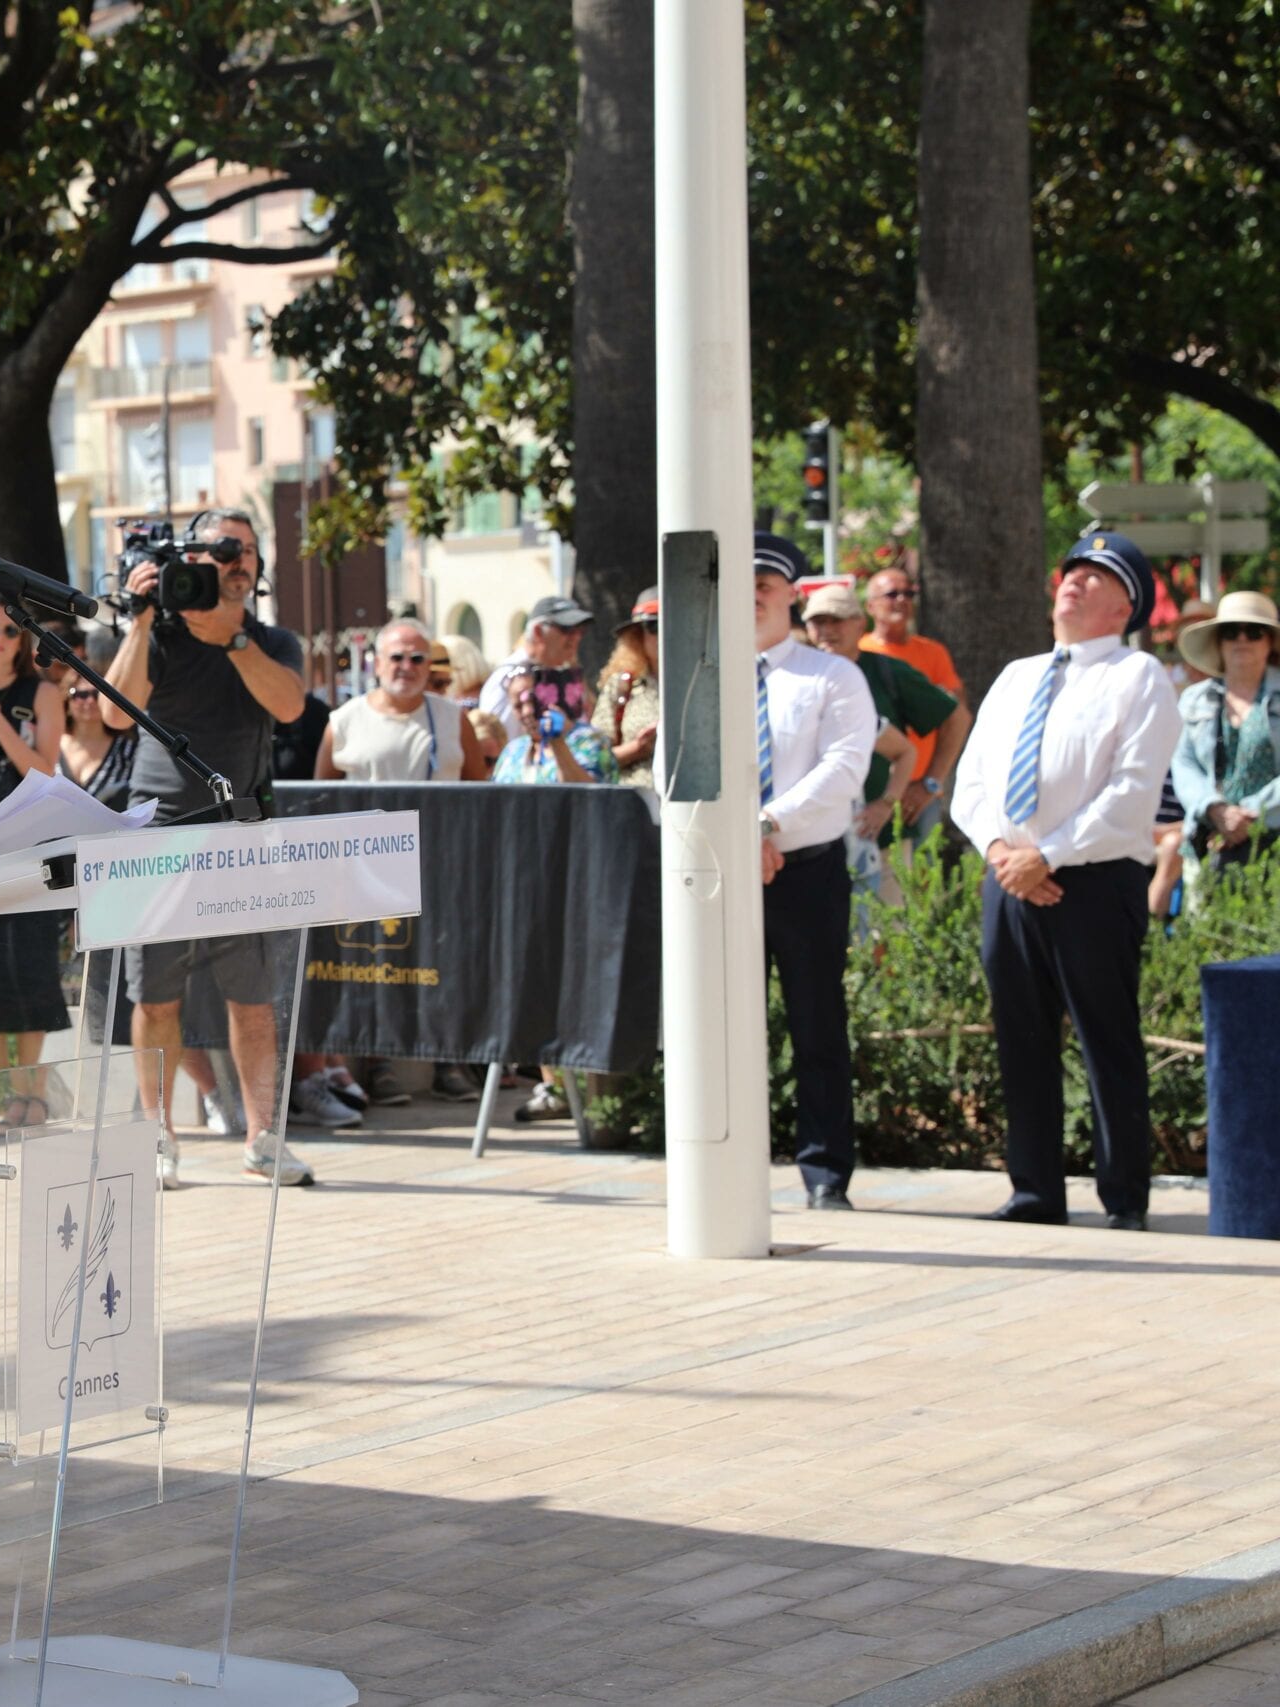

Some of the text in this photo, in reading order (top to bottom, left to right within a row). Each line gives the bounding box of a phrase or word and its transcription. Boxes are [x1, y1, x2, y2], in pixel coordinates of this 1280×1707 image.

[108, 851, 213, 879] ANNIVERSAIRE
[217, 849, 235, 869] DE
[239, 847, 256, 867] LA
[259, 839, 340, 865] LIBÉRATION
[344, 838, 360, 857] DE
[363, 833, 415, 855] CANNES
[196, 890, 316, 917] Dimanche 24 août 2025
[306, 960, 440, 986] #MairiedeCannes
[58, 1371, 120, 1401] Cannes
